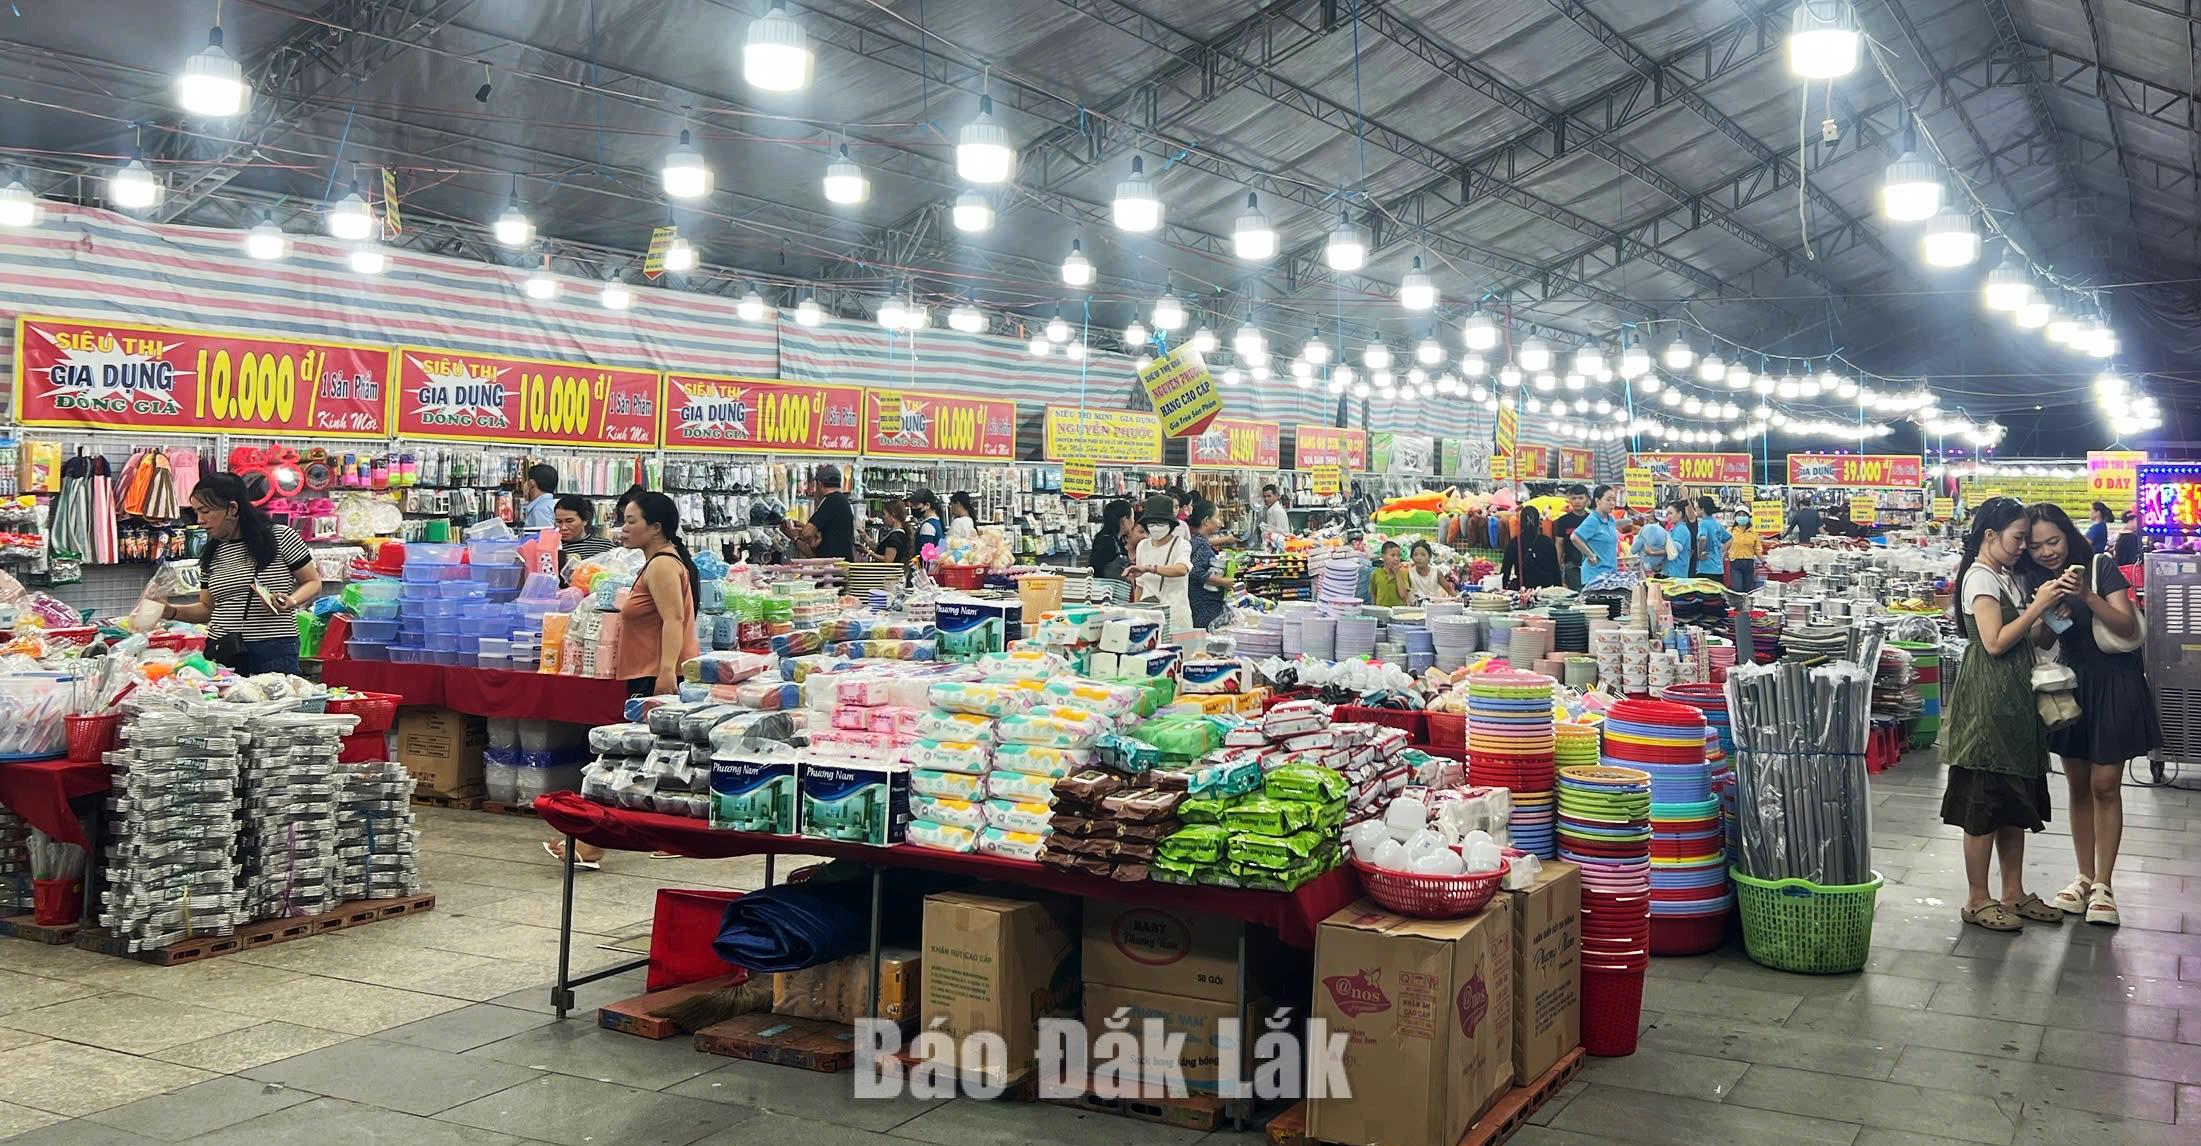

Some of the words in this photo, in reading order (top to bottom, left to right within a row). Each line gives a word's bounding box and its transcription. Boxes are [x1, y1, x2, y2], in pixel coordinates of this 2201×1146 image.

[54, 330, 114, 353] SIÊU
[122, 337, 164, 361] THỊ
[50, 364, 94, 388] GIA
[103, 361, 174, 394] DỤNG
[422, 357, 464, 377] SIÊU
[469, 363, 498, 382] THỊ
[330, 370, 350, 400] Sản
[353, 371, 379, 402] Phẩm
[418, 387, 449, 406] GIA
[455, 384, 504, 411] DỤNG
[683, 382, 714, 398] SIÊU
[719, 385, 742, 401] THỊ
[1181, 389, 1196, 405] CAO
[55, 389, 127, 411] ĐỒNG
[134, 398, 179, 414] GIÁ
[616, 390, 631, 415] Sản
[632, 391, 653, 417] Phẩm
[422, 405, 472, 426] ĐỒNG
[476, 414, 508, 429] GIÁ
[681, 404, 704, 422] GIA
[708, 402, 745, 426] DỤNG
[960, 605, 978, 616] Nam
[712, 763, 742, 776] Phương
[742, 764, 759, 775] Nam
[806, 766, 834, 782] Phương
[835, 770, 855, 782] Nam
[964, 951, 979, 962] CAO
[1198, 1053, 1219, 1067] bóng
